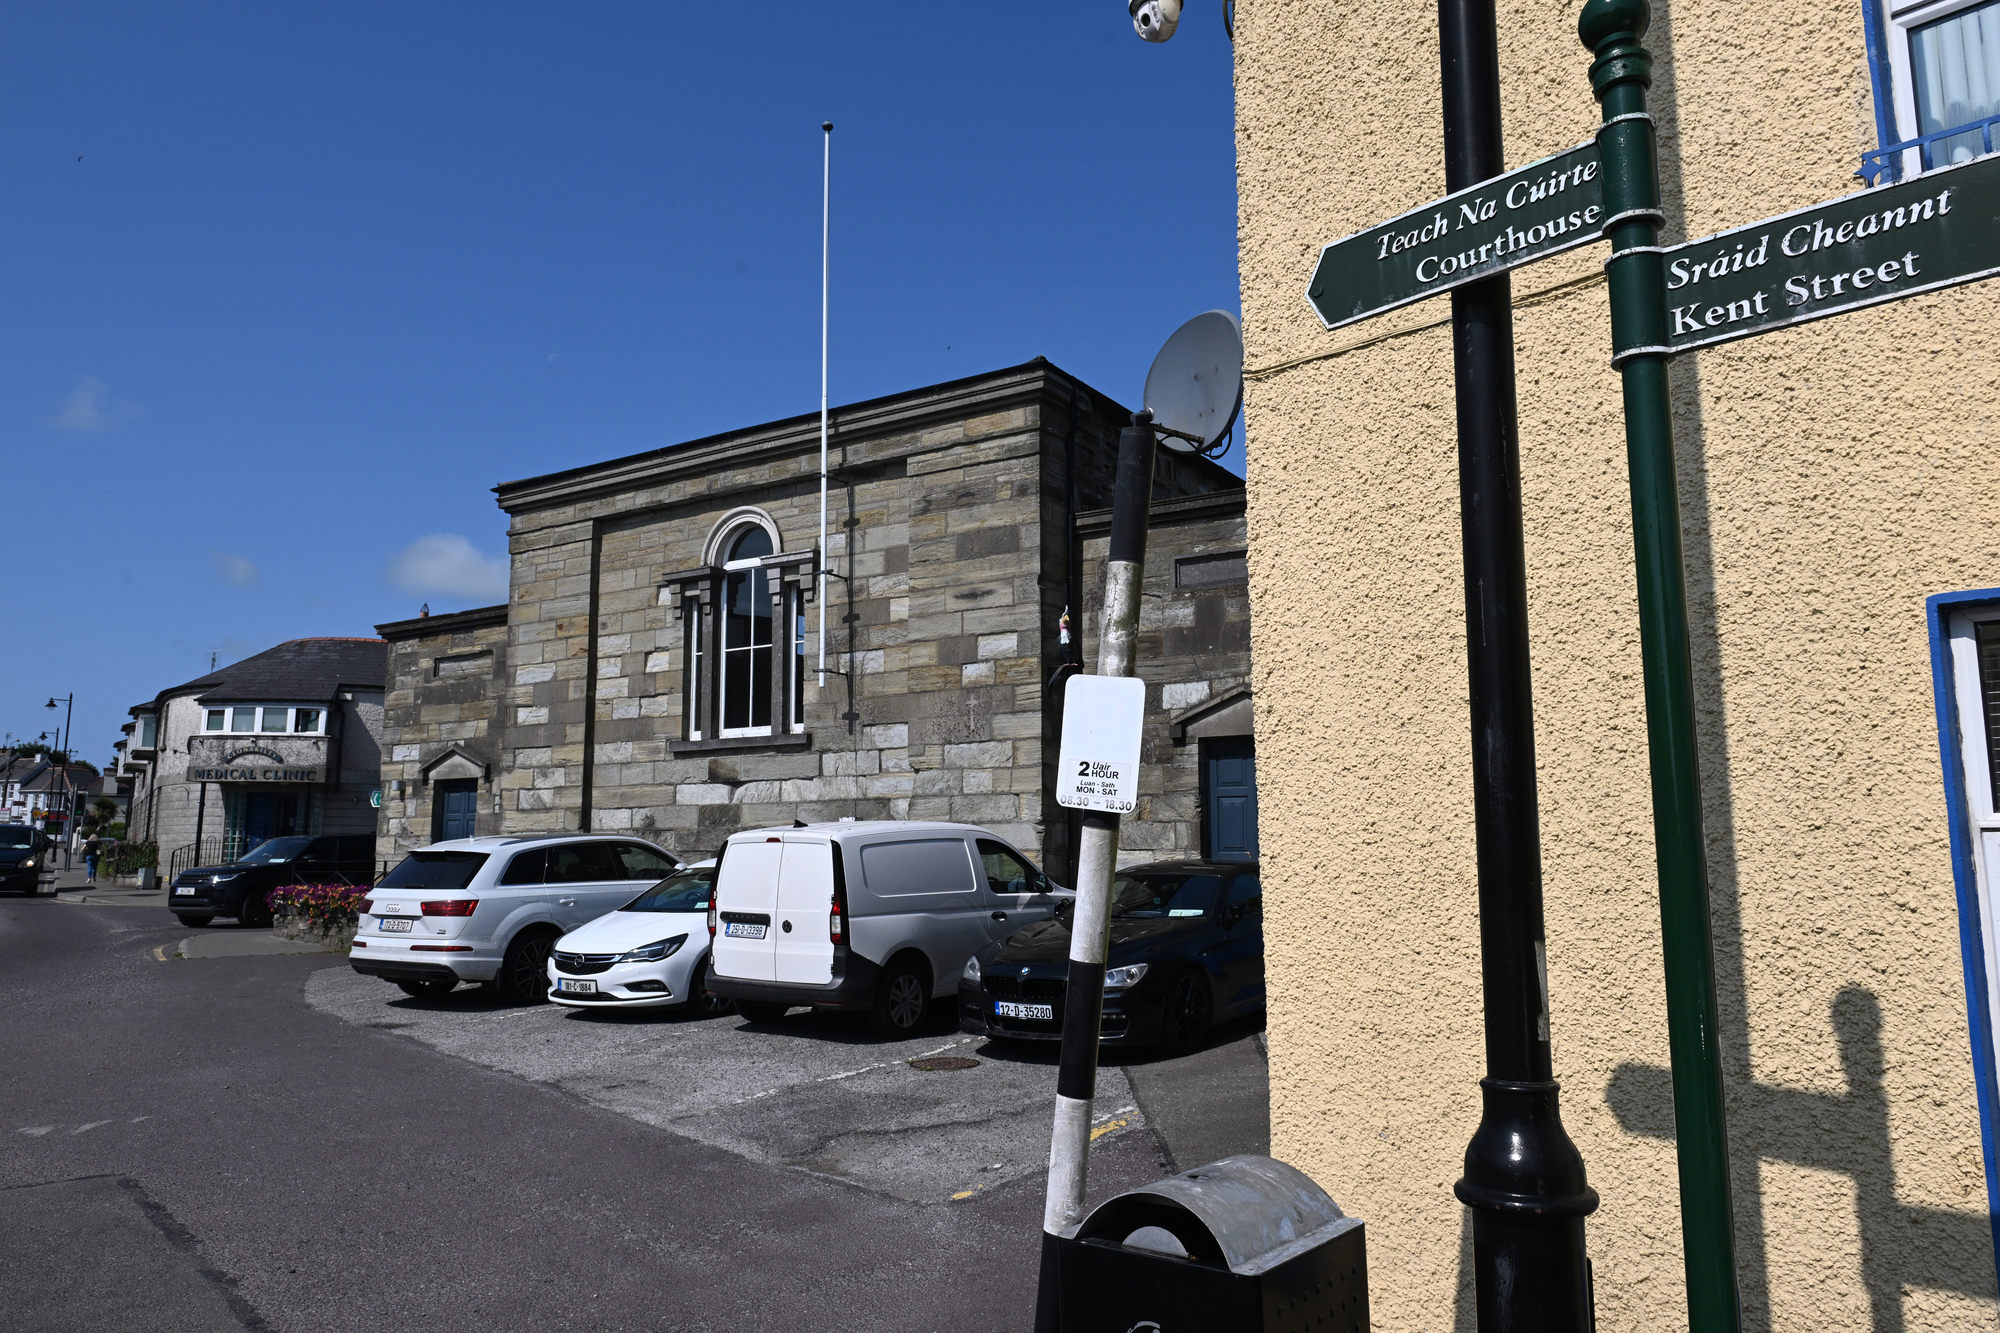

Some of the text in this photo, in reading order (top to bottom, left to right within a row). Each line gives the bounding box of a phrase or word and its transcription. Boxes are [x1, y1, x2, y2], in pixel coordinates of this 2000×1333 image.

[1376, 160, 1598, 261] Teach Na Cúirte
[1415, 204, 1602, 284] Courthouse
[1667, 189, 1953, 290] Sráid Cheannt
[1670, 250, 1921, 338] Kent Street
[227, 746, 277, 759] CLONAKILTY
[195, 769, 317, 780] MEDICAL CLINIC
[1078, 761, 1111, 777] 2 Uair
[1091, 770, 1119, 779] HOUR
[1076, 786, 1095, 794] MON
[1101, 788, 1118, 796] SAT
[1060, 795, 1089, 807] 08.30
[1105, 799, 1132, 812] 18.30
[1000, 1004, 1051, 1019] 12-D-35280
